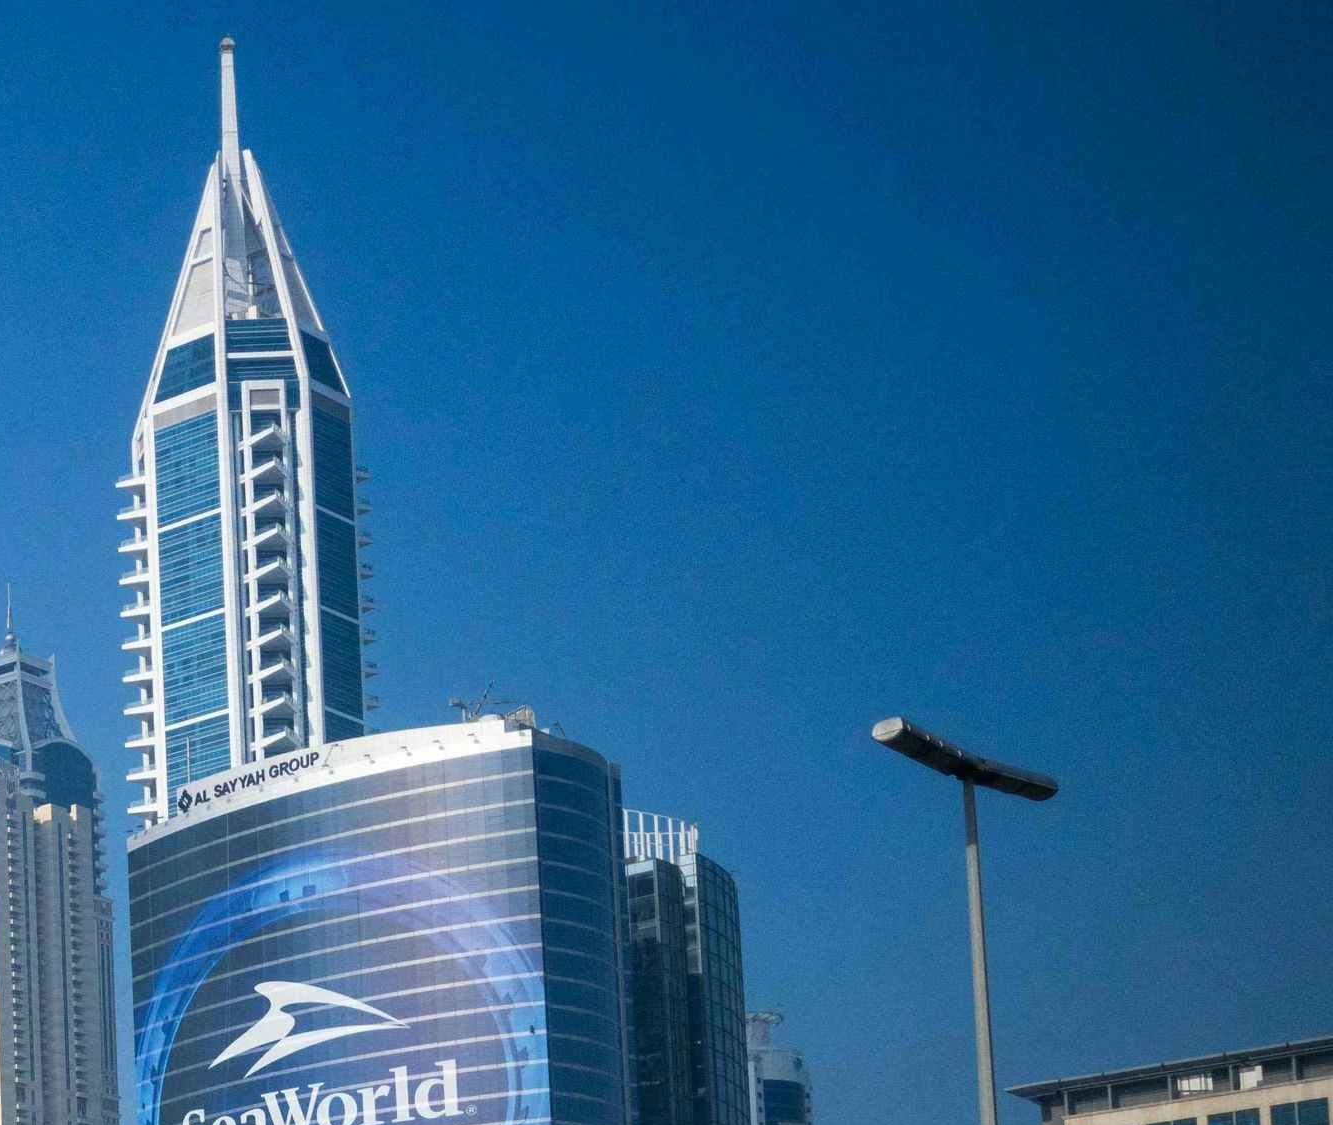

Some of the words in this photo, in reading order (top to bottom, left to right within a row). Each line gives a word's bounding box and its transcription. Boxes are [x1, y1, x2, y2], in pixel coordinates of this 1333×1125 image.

[195, 789, 211, 807] AL
[213, 768, 266, 798] SAYYAH
[269, 752, 320, 781] GROUP
